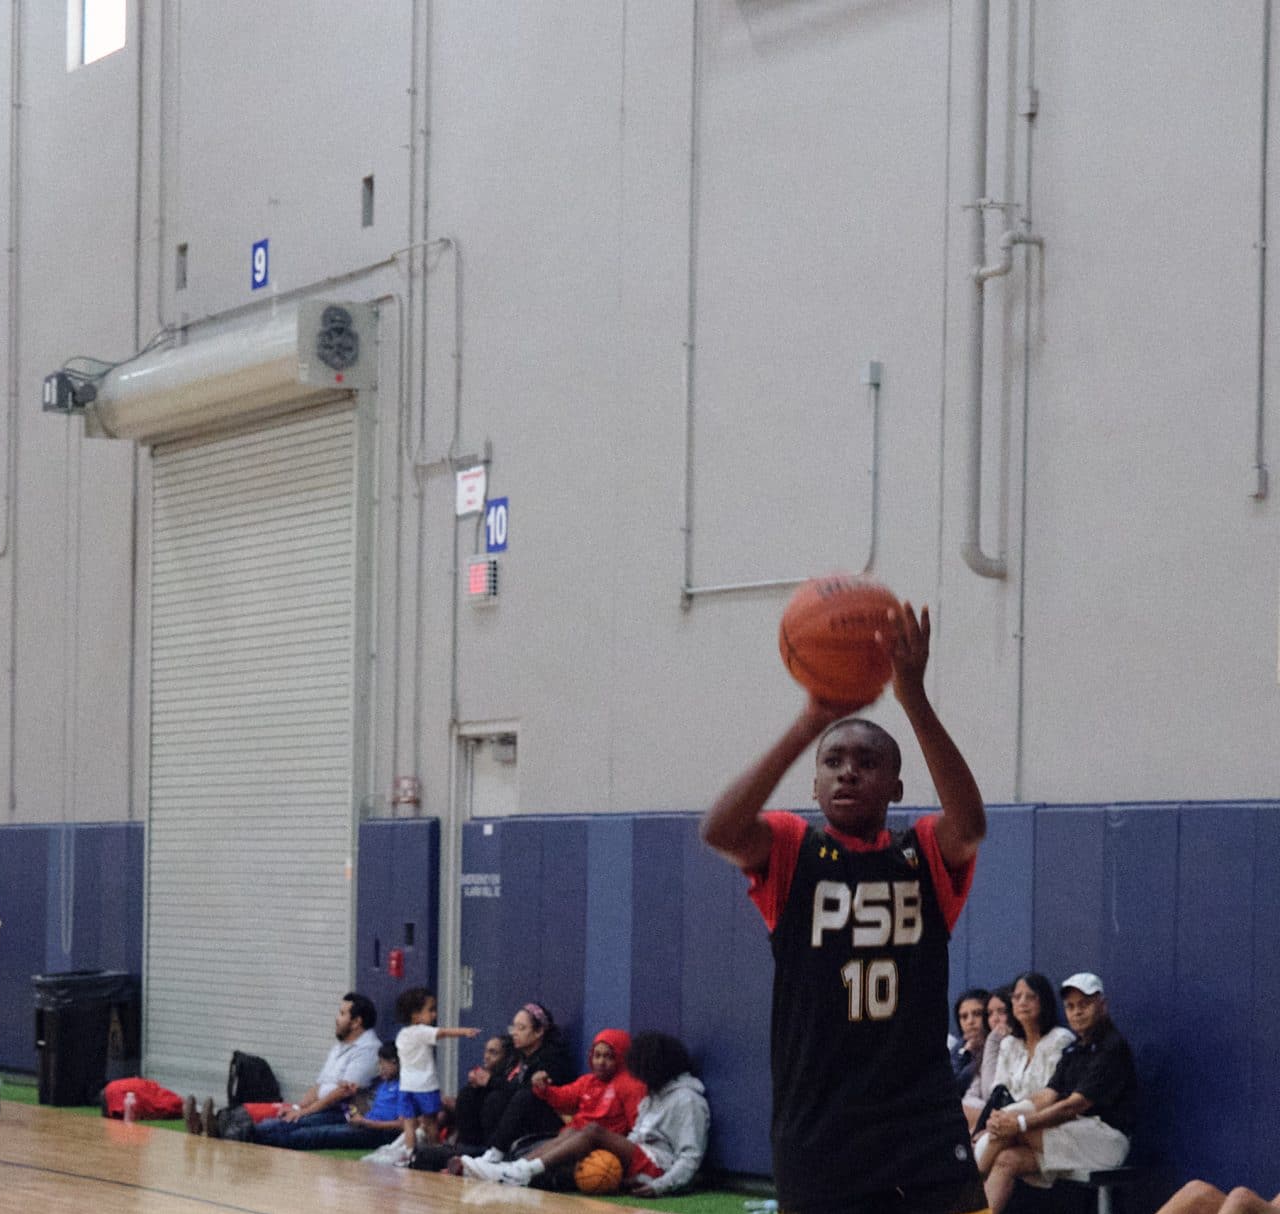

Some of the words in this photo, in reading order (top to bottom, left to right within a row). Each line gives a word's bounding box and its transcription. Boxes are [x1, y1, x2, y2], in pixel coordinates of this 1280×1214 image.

[255, 247, 266, 282] 9
[487, 505, 507, 545] 10
[811, 880, 923, 947] PSB
[841, 958, 899, 1022] 10
